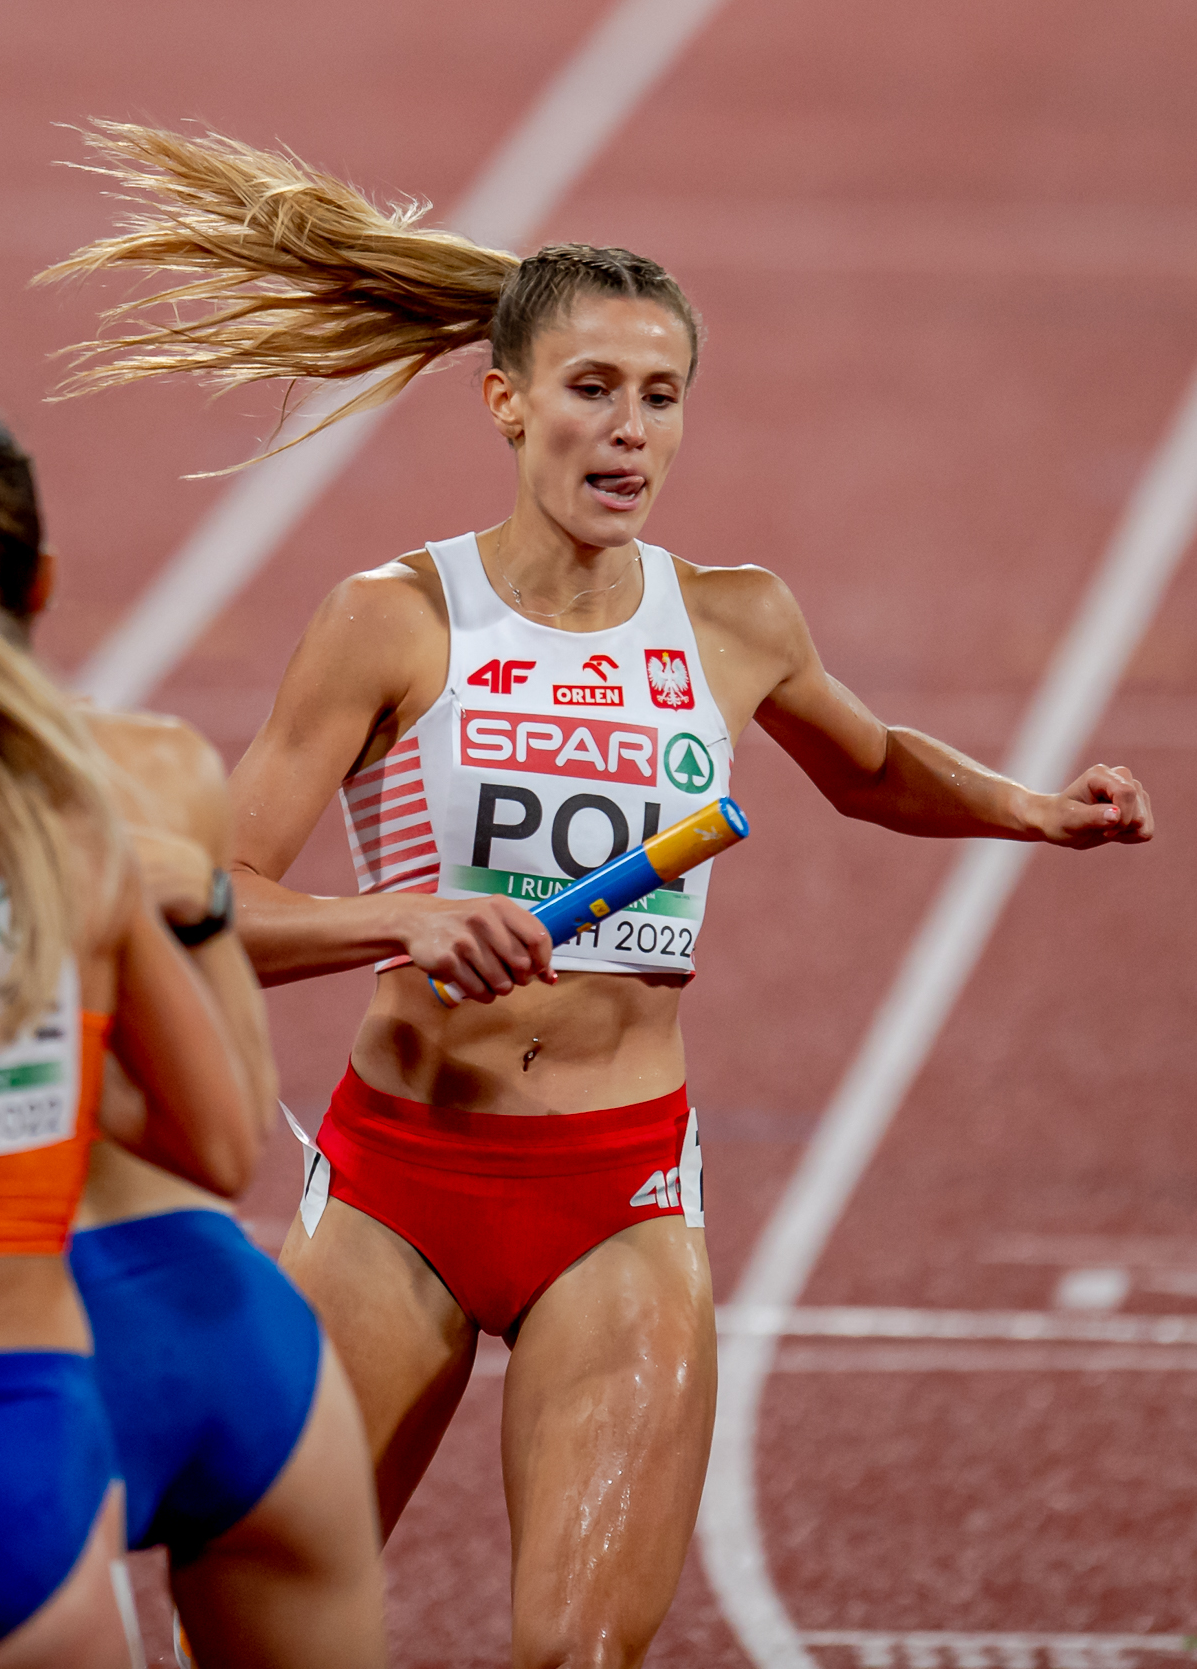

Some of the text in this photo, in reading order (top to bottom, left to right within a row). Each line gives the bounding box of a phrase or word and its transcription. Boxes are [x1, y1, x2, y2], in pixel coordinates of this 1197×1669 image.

[466, 658, 537, 695] 4F
[555, 687, 621, 706] ORLEN
[465, 718, 654, 778] SPAR
[508, 875, 514, 894] I
[614, 920, 693, 959] 2022
